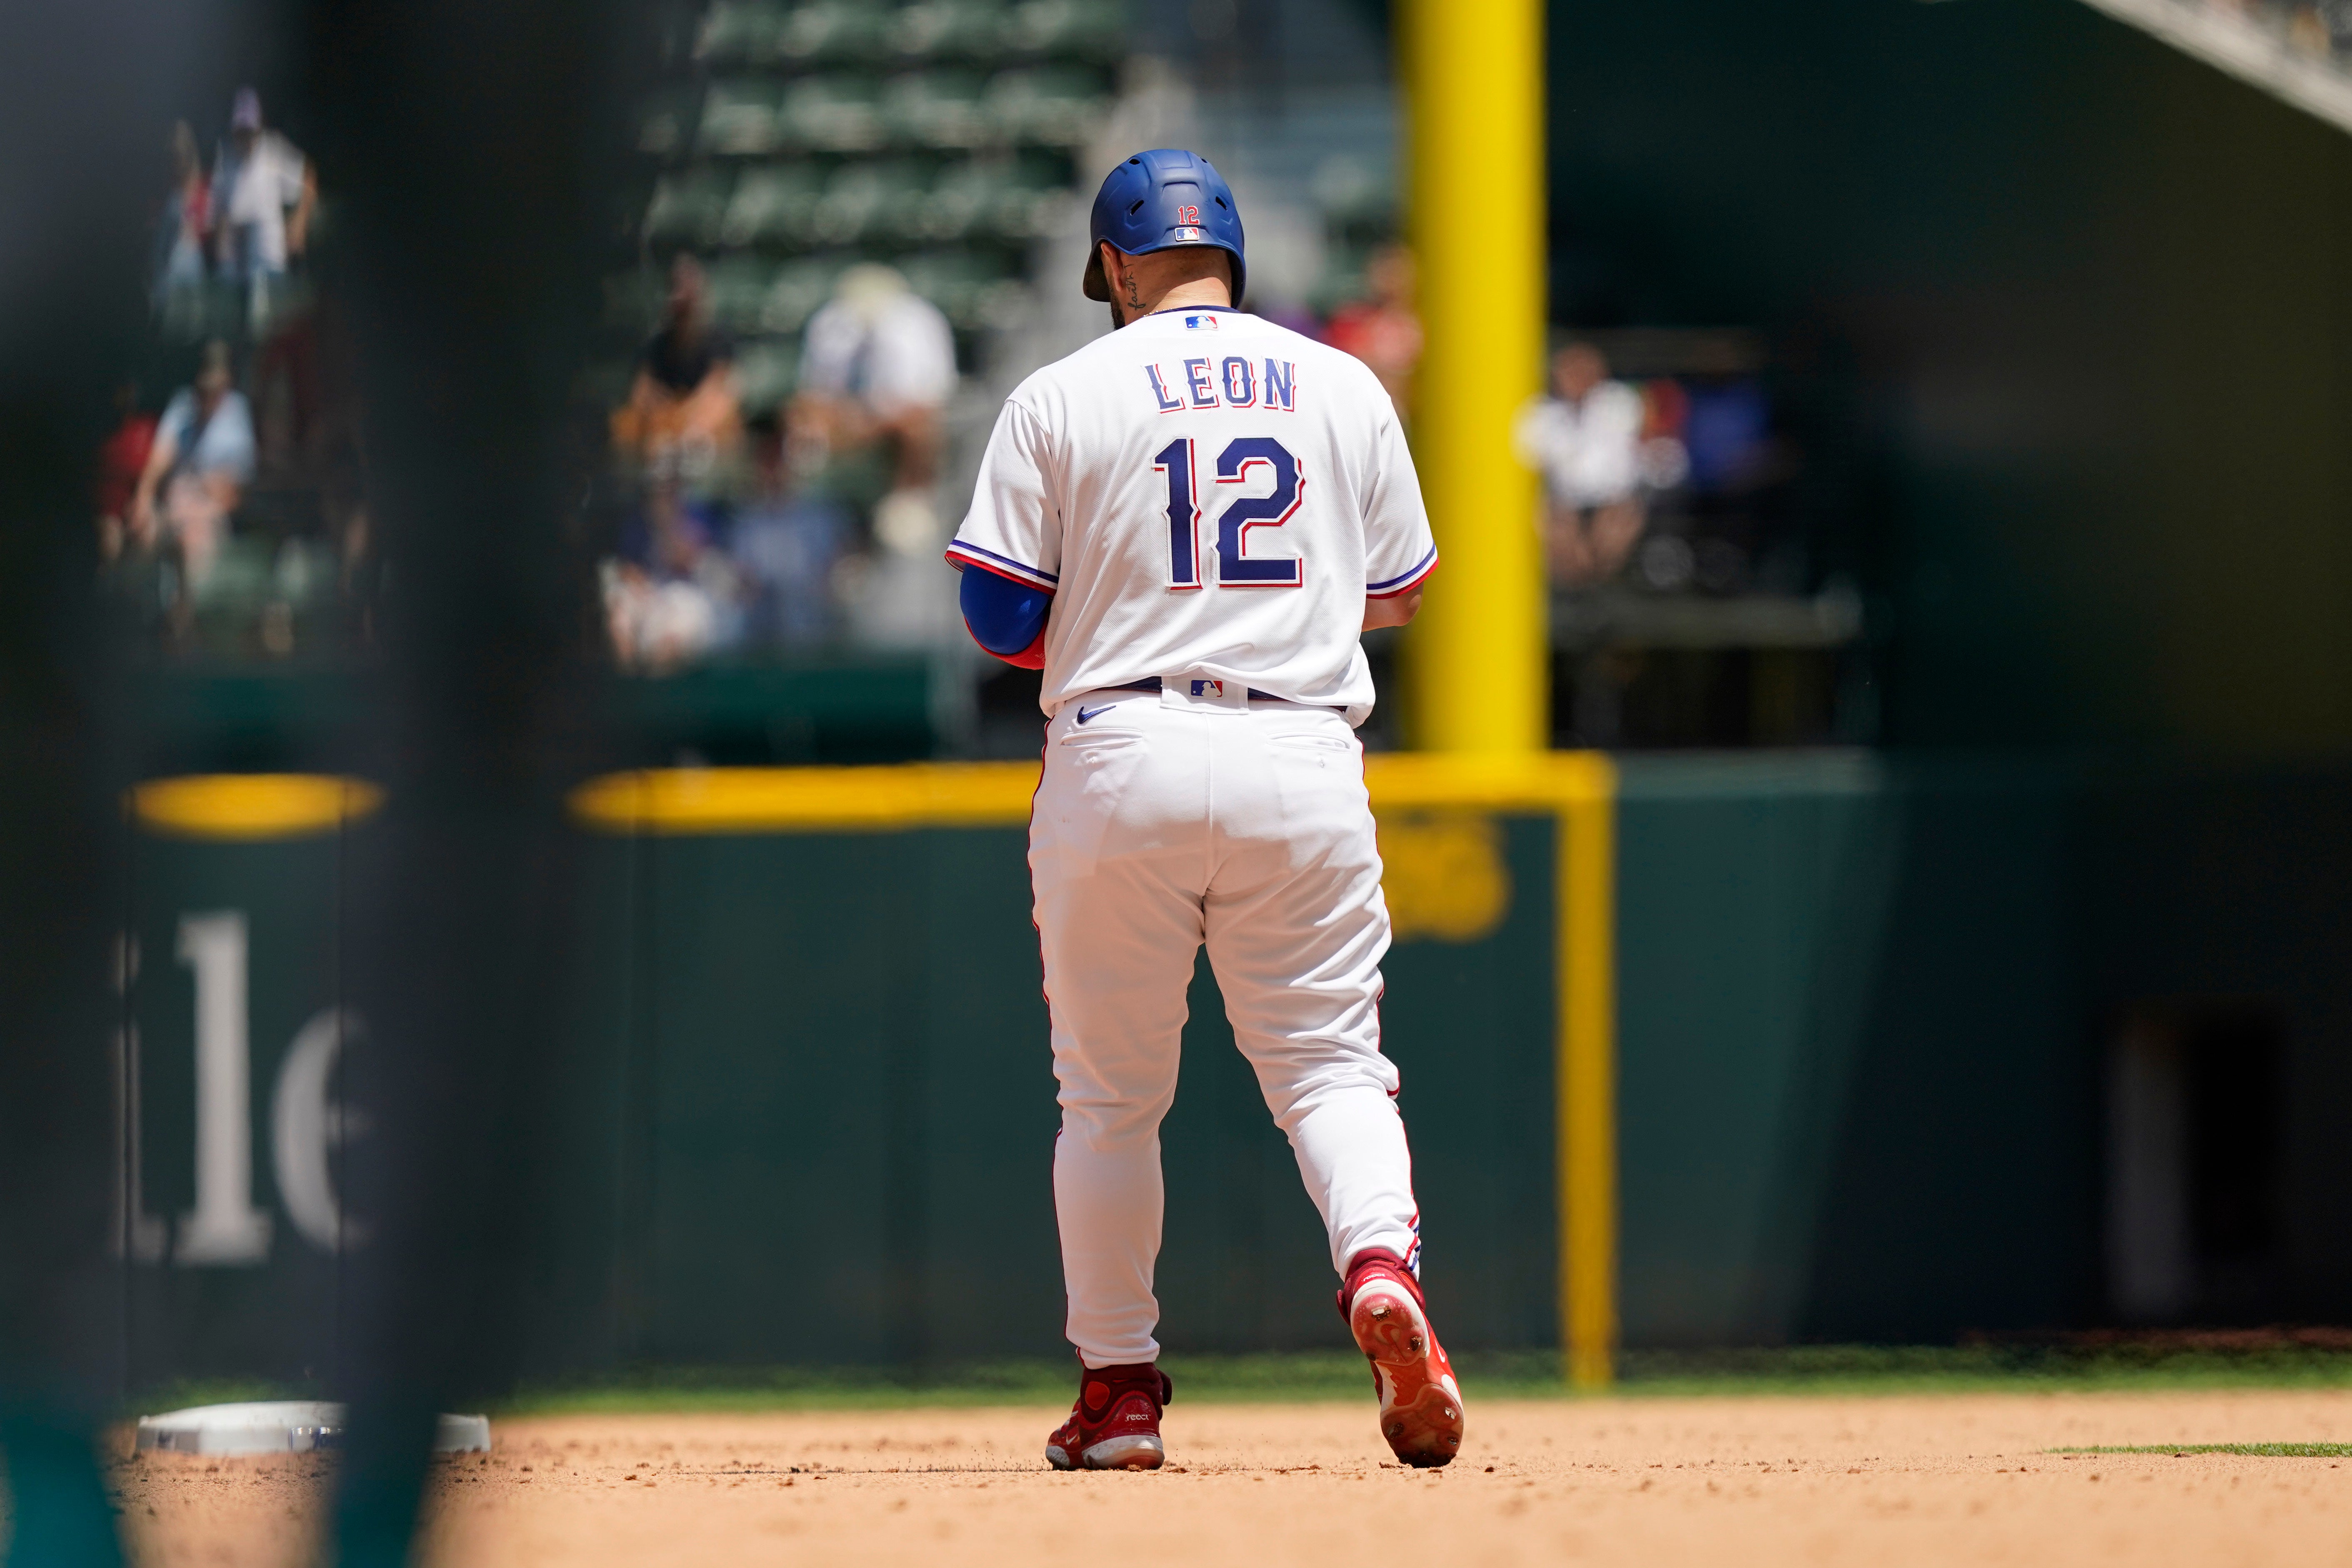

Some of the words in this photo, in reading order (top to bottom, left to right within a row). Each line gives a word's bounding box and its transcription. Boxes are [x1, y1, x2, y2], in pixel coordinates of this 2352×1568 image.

[1178, 206, 1200, 225] 12
[1140, 356, 1297, 414] LEON
[1151, 434, 1306, 590] 12
